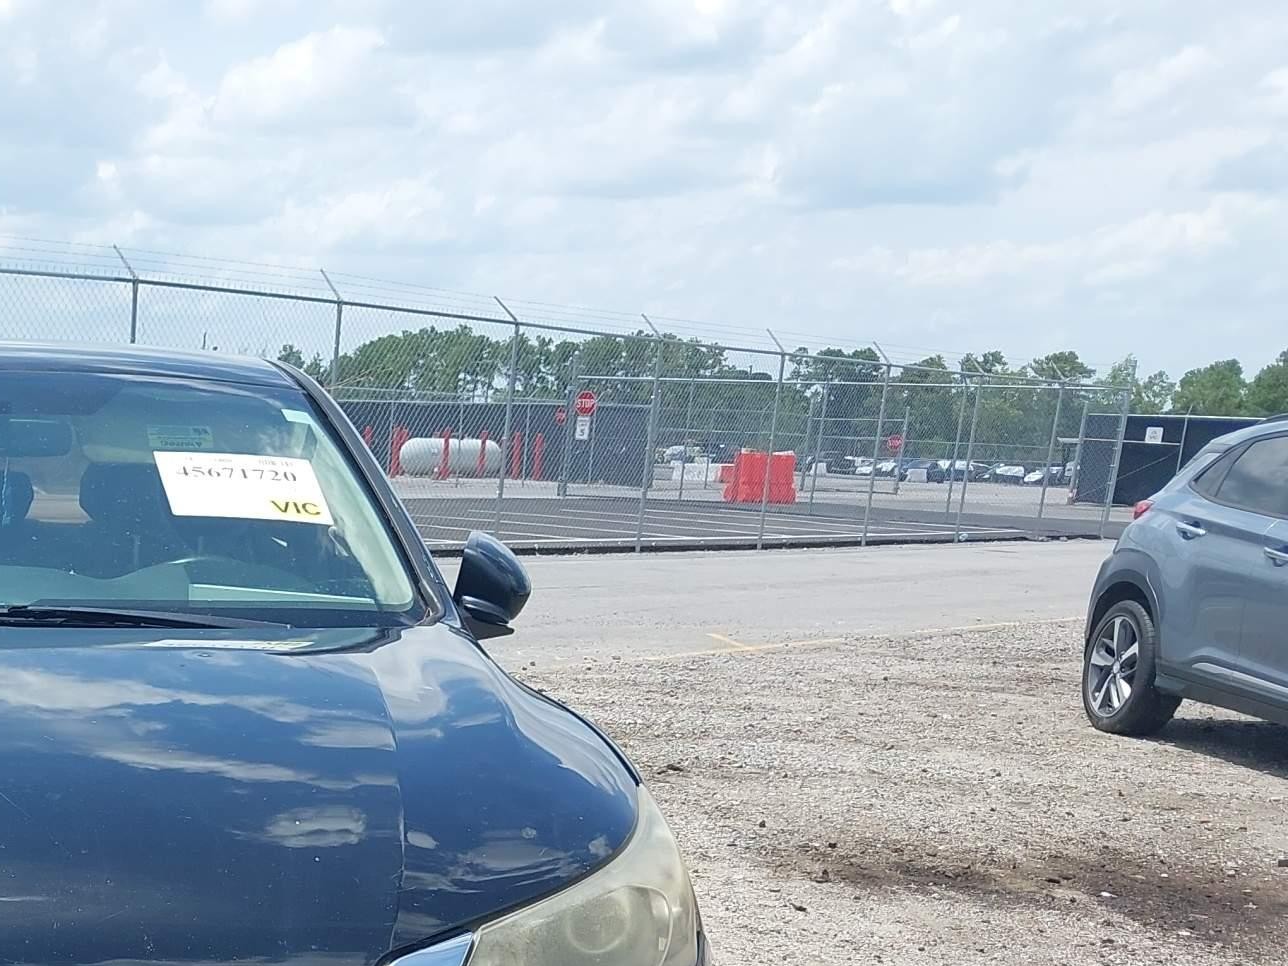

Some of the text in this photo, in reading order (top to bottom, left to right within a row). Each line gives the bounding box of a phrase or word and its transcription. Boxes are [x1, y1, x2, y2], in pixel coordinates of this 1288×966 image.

[577, 398, 595, 408] STOP
[175, 465, 297, 482] 45671720
[271, 499, 321, 516] VIC
